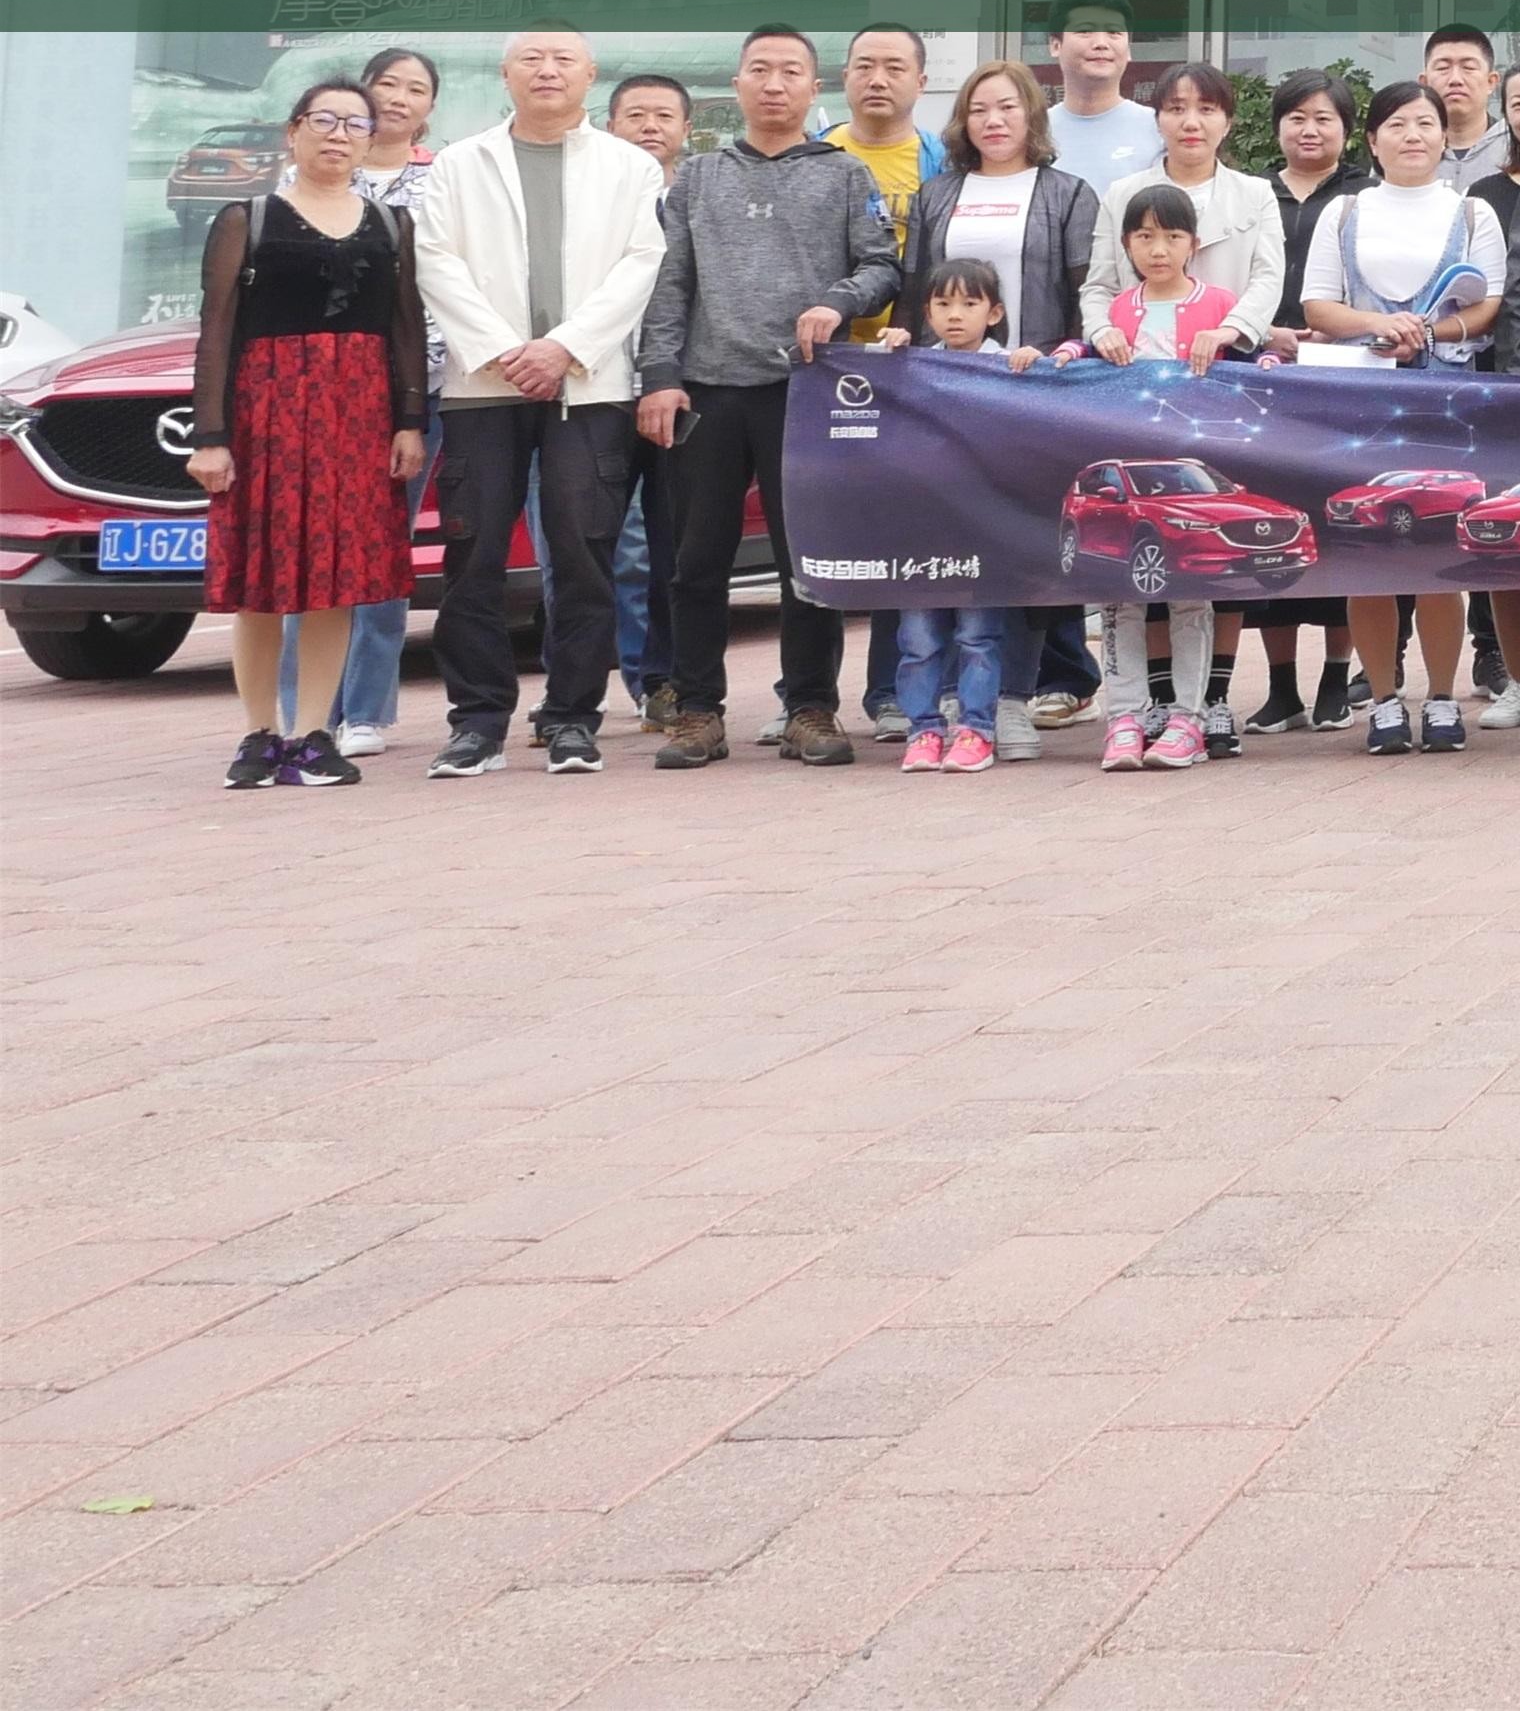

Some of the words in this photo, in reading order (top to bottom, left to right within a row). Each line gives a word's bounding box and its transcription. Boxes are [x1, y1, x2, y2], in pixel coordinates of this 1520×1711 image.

[801, 555, 889, 580] 长安马自达
